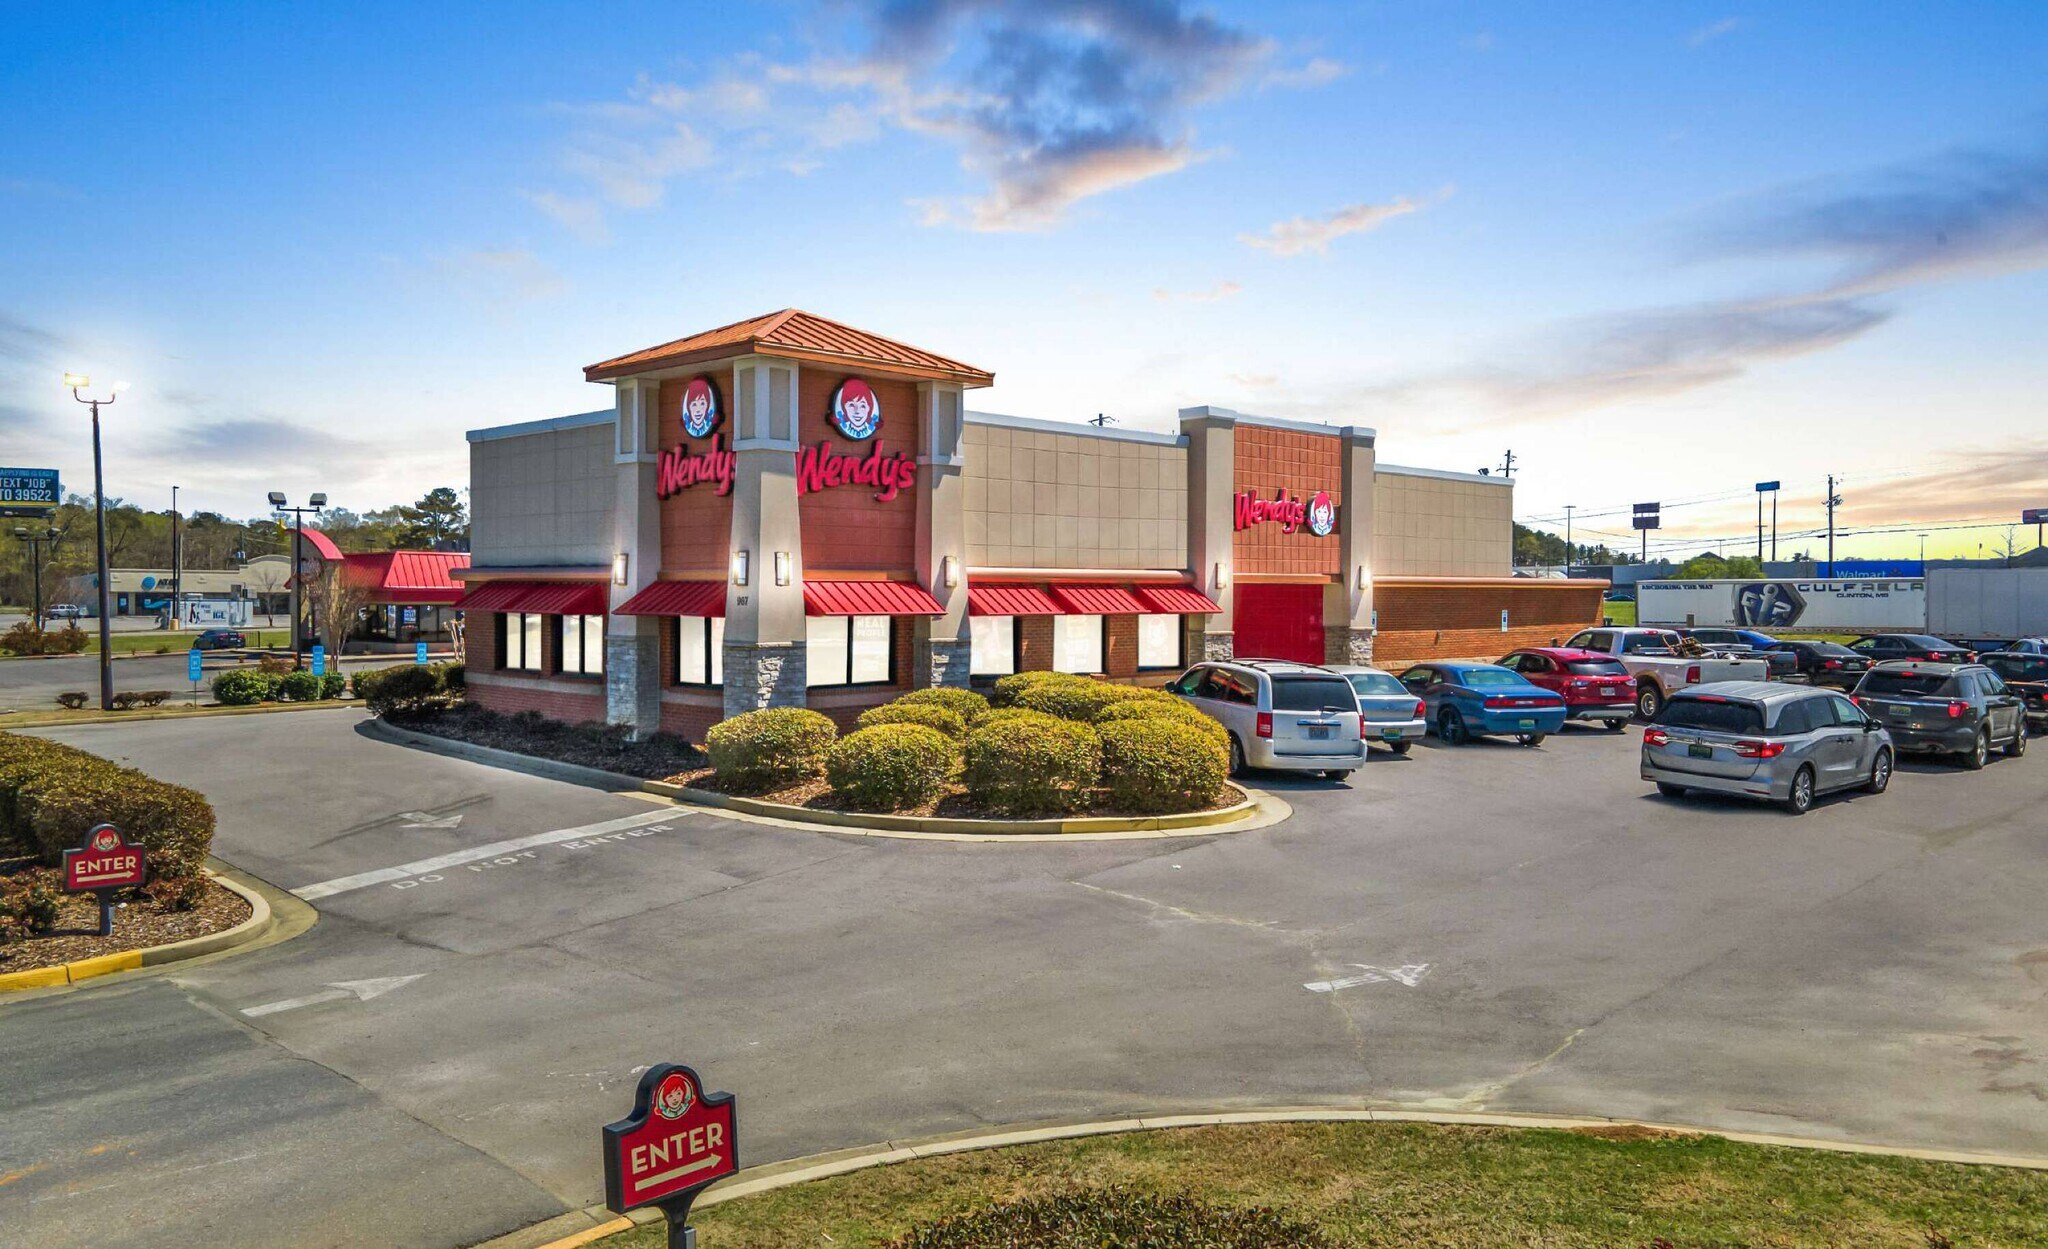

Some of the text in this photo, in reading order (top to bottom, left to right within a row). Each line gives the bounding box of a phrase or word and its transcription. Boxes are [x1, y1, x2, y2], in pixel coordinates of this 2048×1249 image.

[796, 438, 917, 501] Wendy's
[15, 488, 52, 501] 39522
[1234, 487, 1306, 534] Wendy's
[1836, 570, 1887, 578] Walmart
[75, 855, 137, 875] ENTER
[391, 825, 675, 890] DO NOT ENTER
[631, 1122, 724, 1175] ENTER
